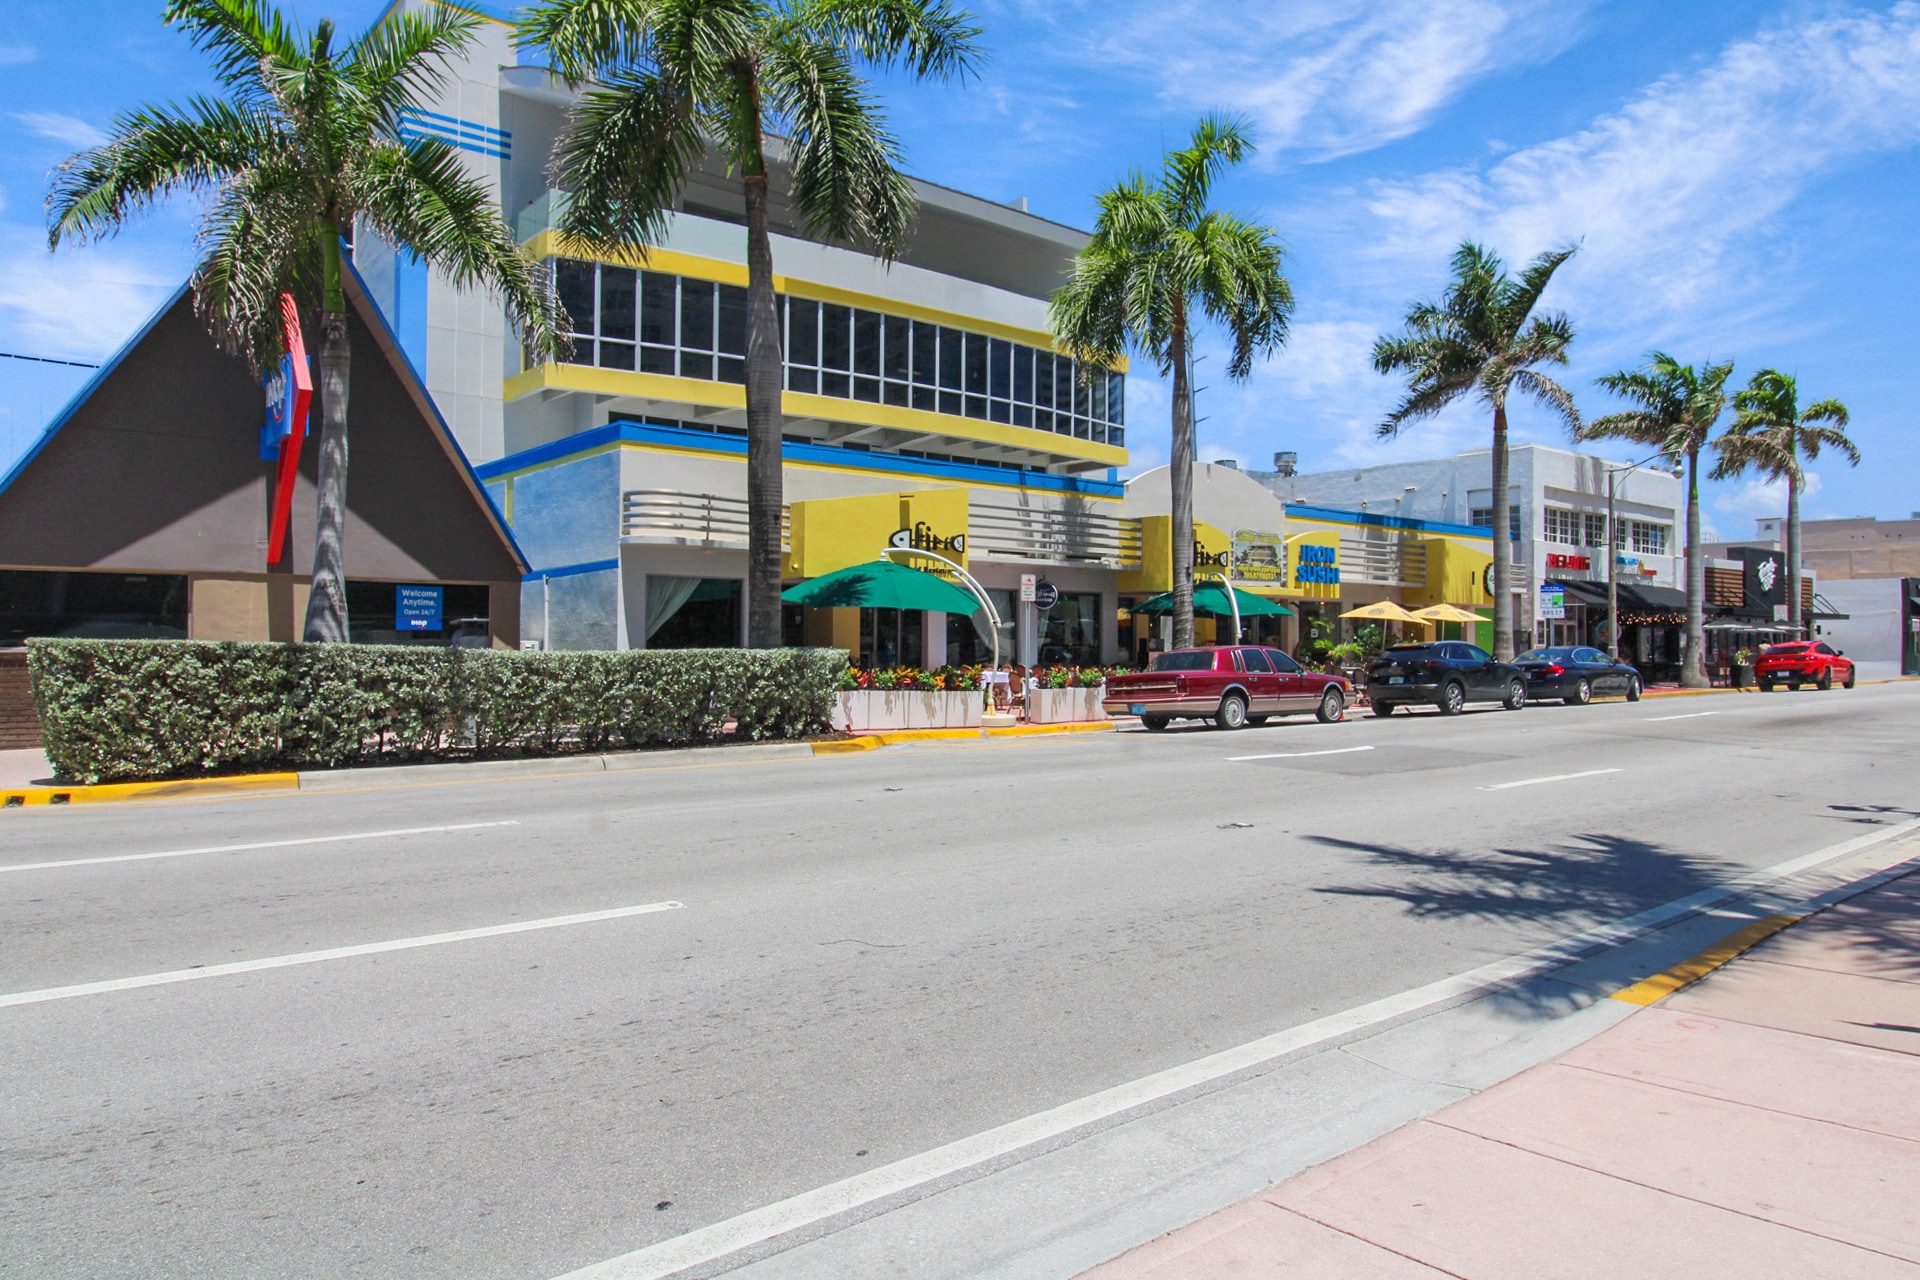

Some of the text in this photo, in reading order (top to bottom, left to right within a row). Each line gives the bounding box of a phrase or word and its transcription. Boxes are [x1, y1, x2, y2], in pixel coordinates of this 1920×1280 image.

[1300, 545, 1336, 565] IRON
[1297, 564, 1340, 584] SUSHI
[402, 589, 437, 598] Welcome
[403, 598, 436, 607] Anytime.
